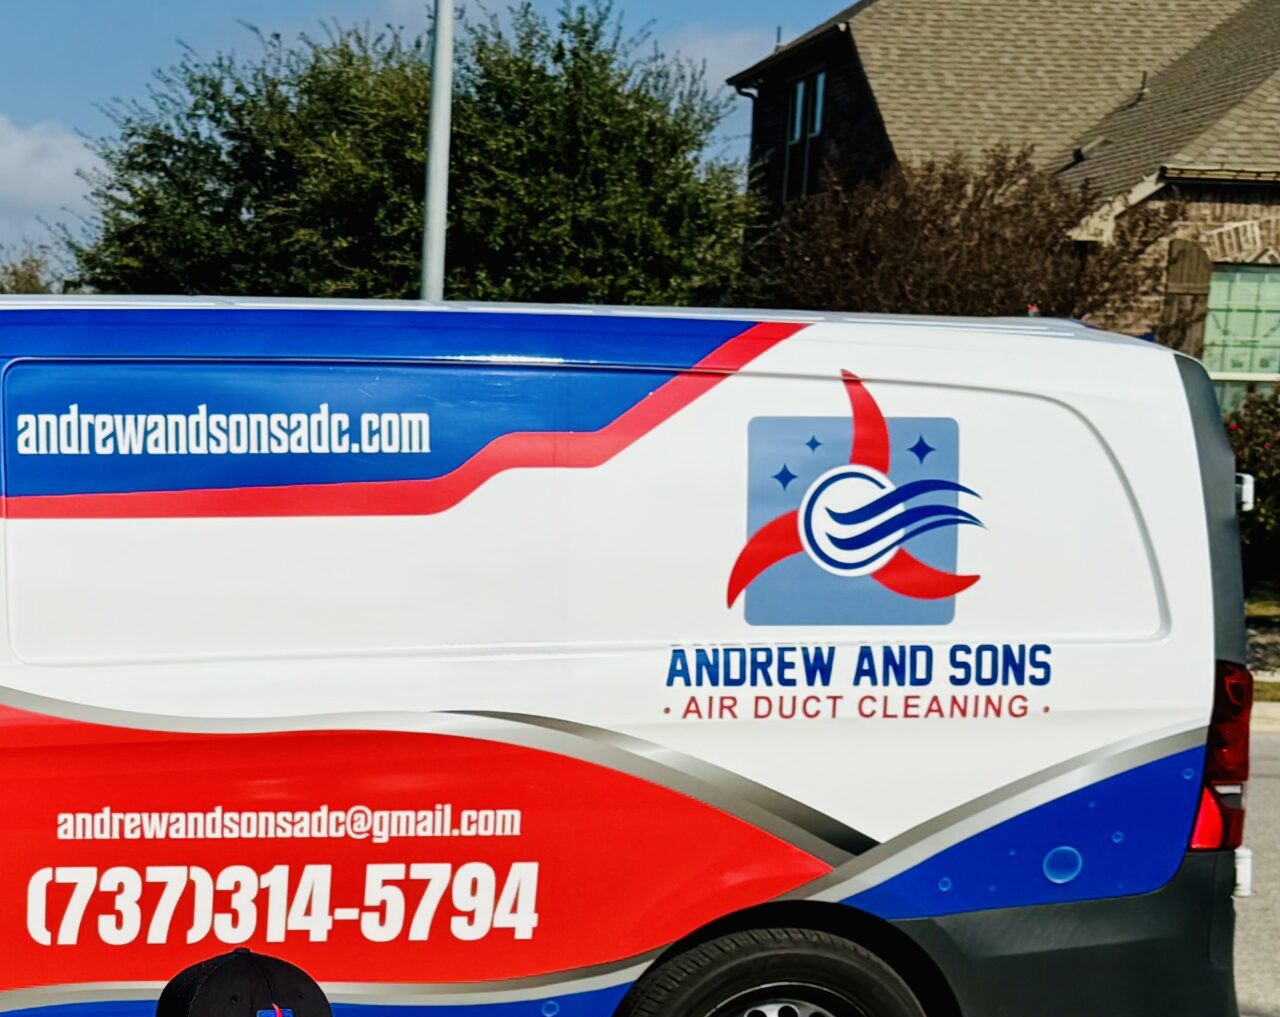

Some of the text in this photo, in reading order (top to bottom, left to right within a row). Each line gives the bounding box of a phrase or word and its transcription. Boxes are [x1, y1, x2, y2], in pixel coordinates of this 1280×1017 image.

[17, 403, 431, 454] andrewandsonsadc.com
[666, 644, 1052, 687] ANDREW AND SONS
[682, 695, 1029, 719] AIR DUCT CLEANING
[57, 803, 521, 843] andrewandsonsadc@gmail.com
[27, 861, 539, 946] (737)314-5794
